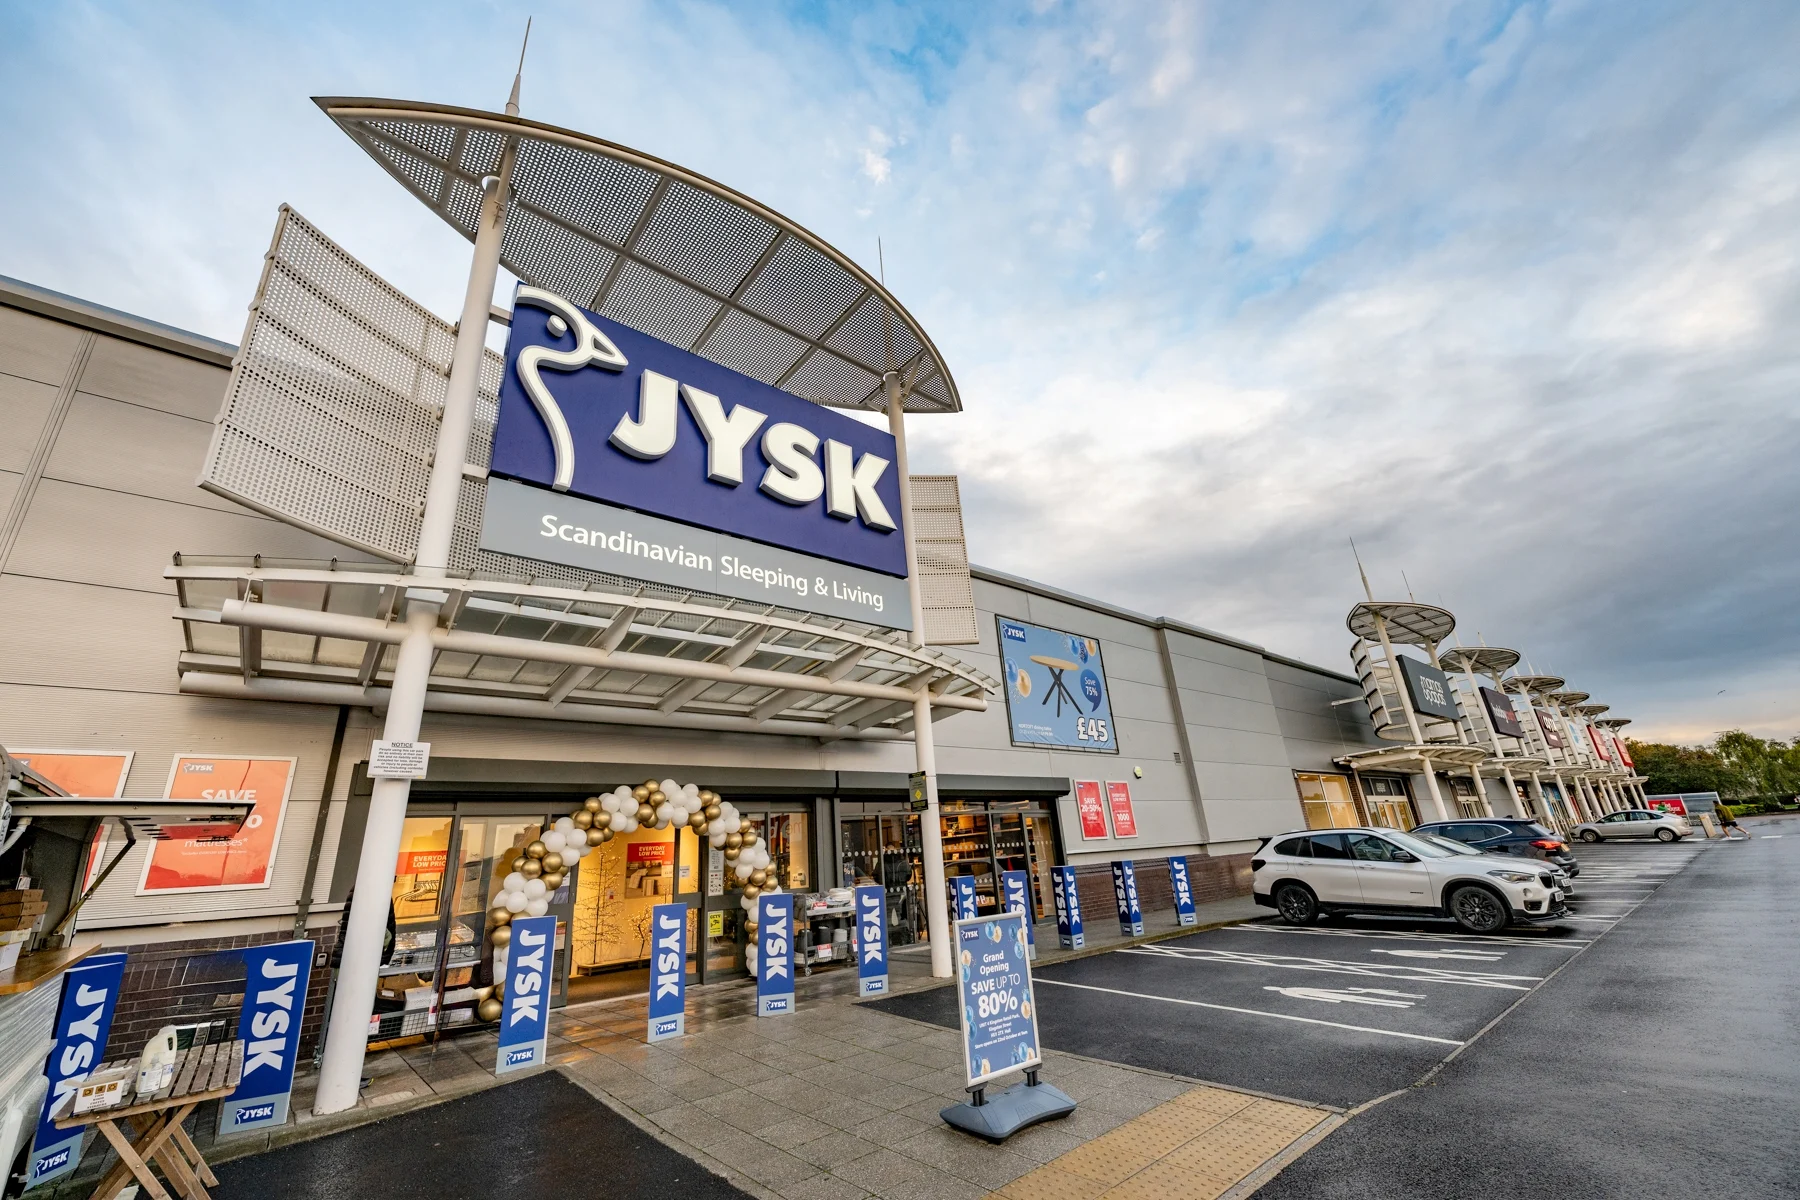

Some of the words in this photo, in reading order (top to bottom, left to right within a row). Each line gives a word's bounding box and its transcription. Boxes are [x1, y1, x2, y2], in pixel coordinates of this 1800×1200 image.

[608, 368, 898, 534] JYSK
[540, 514, 712, 571] Scandinavian
[720, 555, 808, 596] Sleeping
[813, 577, 828, 595] &
[832, 581, 884, 611] Living
[1008, 628, 1024, 638] JYSK
[1084, 676, 1096, 686] Save
[1085, 686, 1098, 696] 75%
[1419, 675, 1444, 693] mamas
[1077, 717, 1108, 742] £45
[189, 764, 214, 772] JYSK
[201, 789, 257, 800] SAVE
[1081, 804, 1102, 812] 20-50%
[1117, 813, 1130, 821] 1000
[1113, 866, 1129, 914] JYSK
[1125, 866, 1139, 914] JYSK
[1174, 861, 1191, 906] JYSK
[961, 884, 976, 920] JYS
[1053, 872, 1068, 925] JYSK
[1066, 872, 1080, 925] JYSK
[861, 894, 882, 965] JYSK
[965, 930, 978, 939] JYSK
[766, 902, 788, 981] JYSK
[657, 914, 681, 1001] JYSK
[983, 950, 1004, 963] Grand
[510, 929, 546, 1028] JYSK
[980, 962, 1009, 976] Opening
[870, 981, 883, 990] JYSK
[971, 978, 995, 995] SAVE
[996, 976, 1007, 989] UP
[1008, 973, 1021, 987] TO
[770, 1000, 787, 1008] JYSK
[978, 989, 1018, 1018] 80%
[243, 958, 298, 1079] JYSK
[660, 1022, 677, 1032] JYSK
[47, 984, 108, 1123] JYSK
[512, 1050, 533, 1061] JYSK
[243, 1105, 273, 1120] JYSK
[43, 1150, 69, 1171] JYSK
